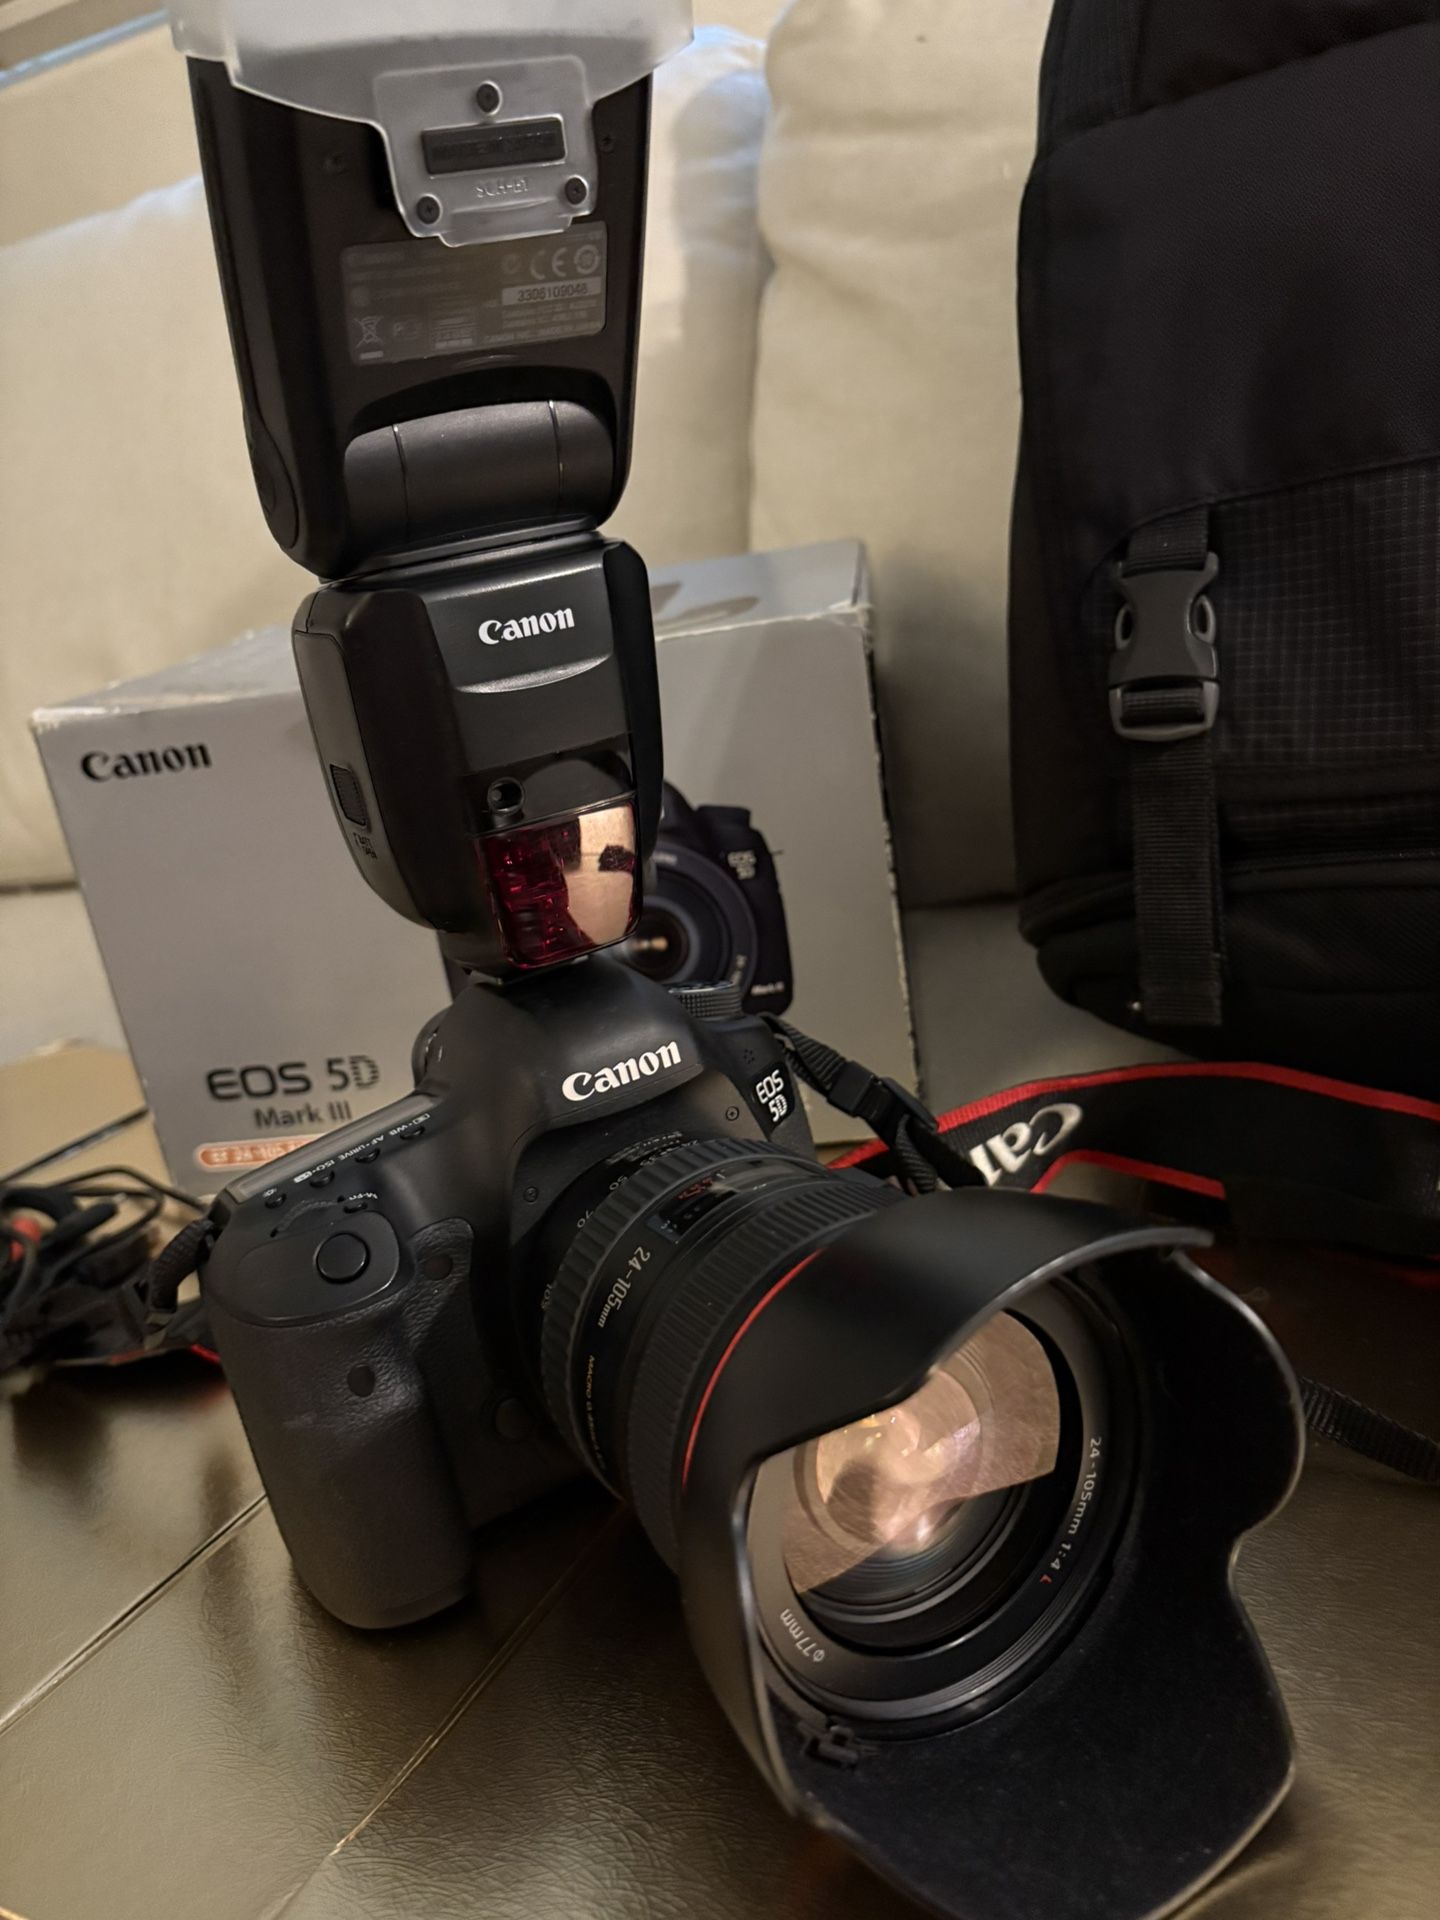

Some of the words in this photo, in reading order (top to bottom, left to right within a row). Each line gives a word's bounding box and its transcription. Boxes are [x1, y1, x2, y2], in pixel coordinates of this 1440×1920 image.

[478, 607, 576, 645] Canon
[80, 743, 212, 783] Canon
[206, 1061, 312, 1102] EOS
[325, 1054, 380, 1092] 5D
[562, 1041, 682, 1102] Canon
[755, 1069, 785, 1104] EOS
[253, 1102, 324, 1129] Mark
[328, 1100, 354, 1122] III
[768, 1093, 788, 1122] 5D
[597, 1246, 652, 1329] 24-105mm
[1067, 1437, 1102, 1535] 24-105mm
[1050, 1542, 1072, 1571] 1:4
